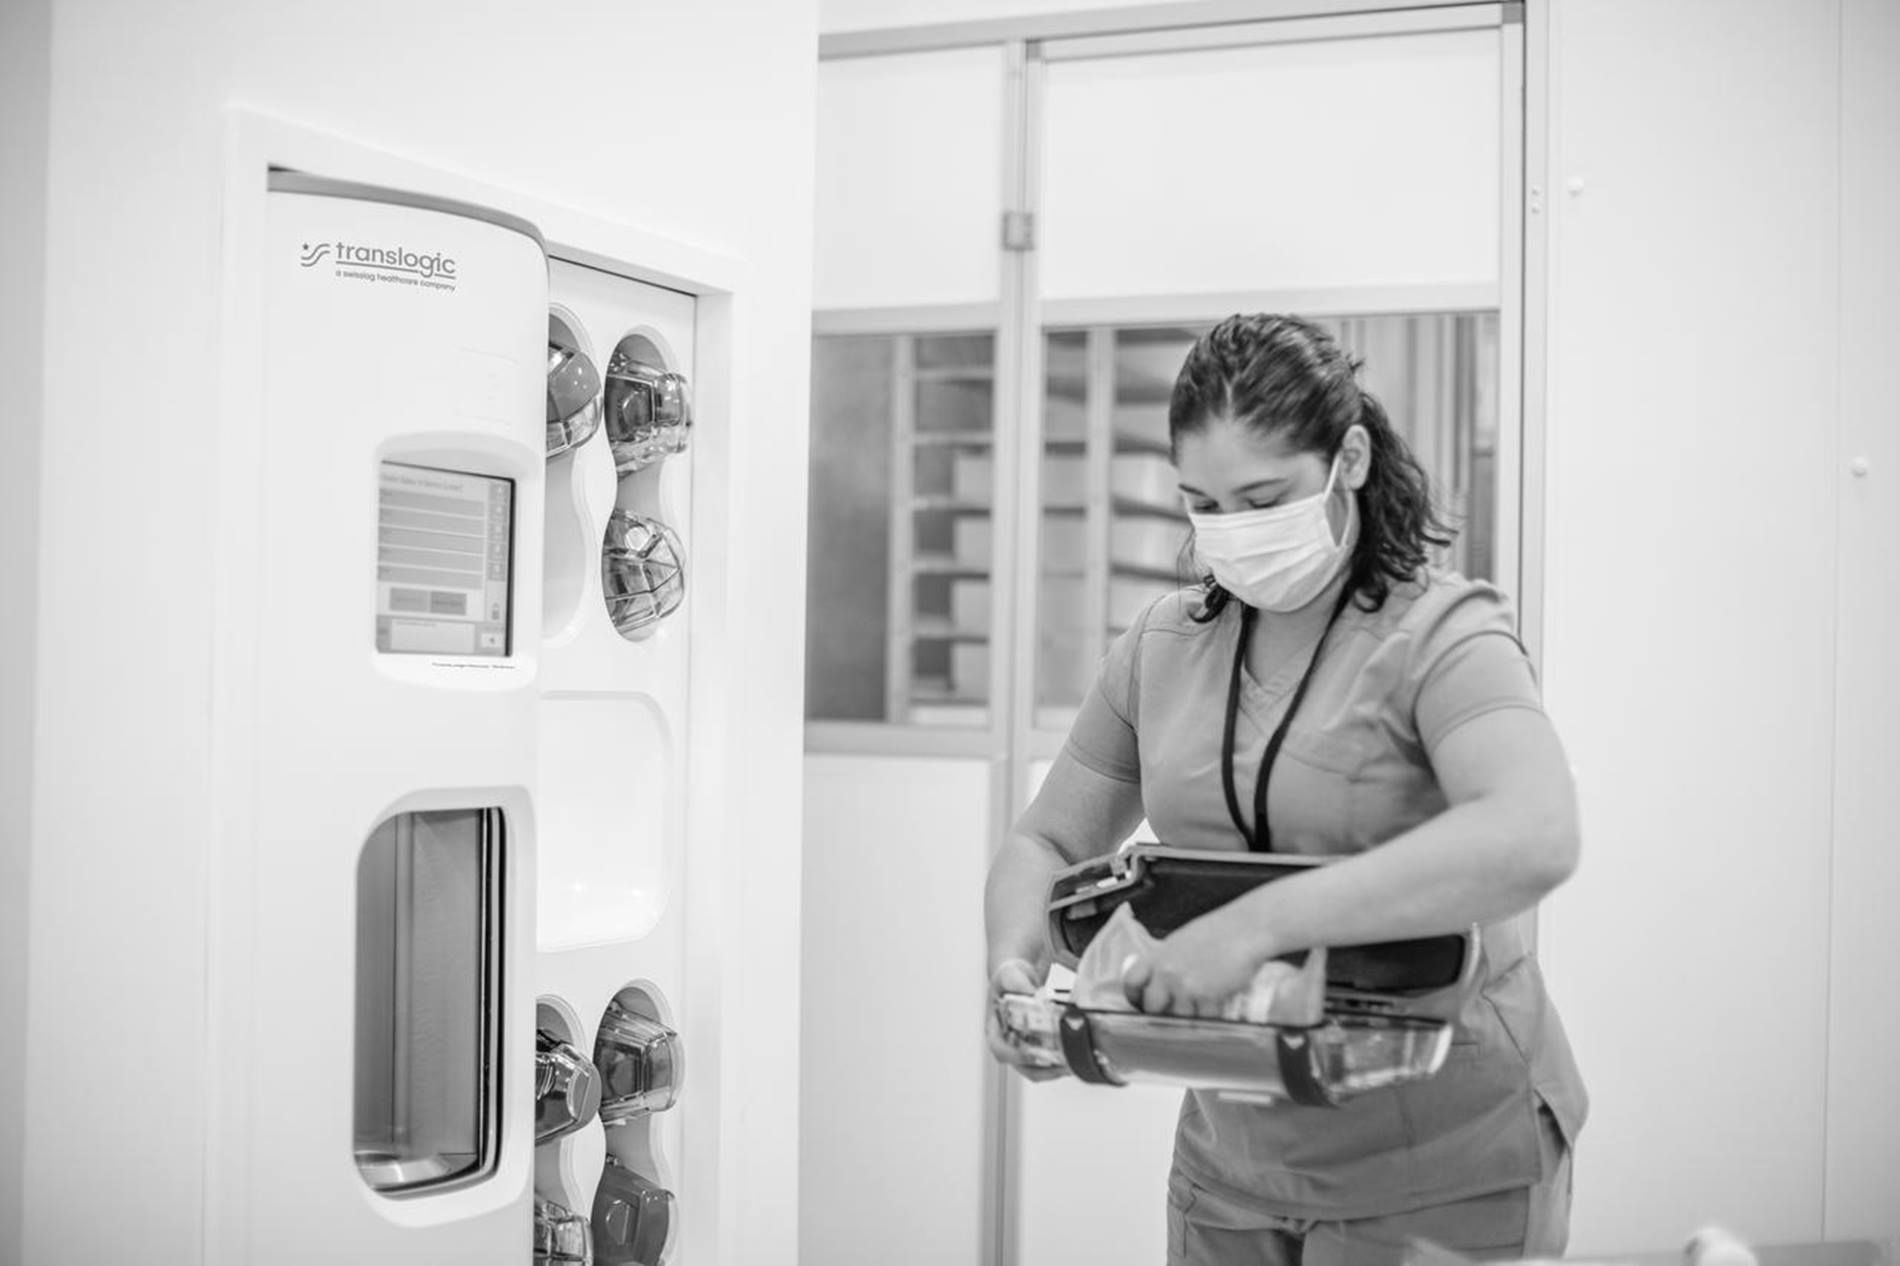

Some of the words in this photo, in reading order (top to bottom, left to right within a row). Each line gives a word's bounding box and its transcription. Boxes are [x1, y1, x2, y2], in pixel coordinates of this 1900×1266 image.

[335, 242, 456, 278] translogic
[343, 270, 376, 282] swisslog
[377, 273, 419, 286] healthcare
[420, 280, 457, 291] company
